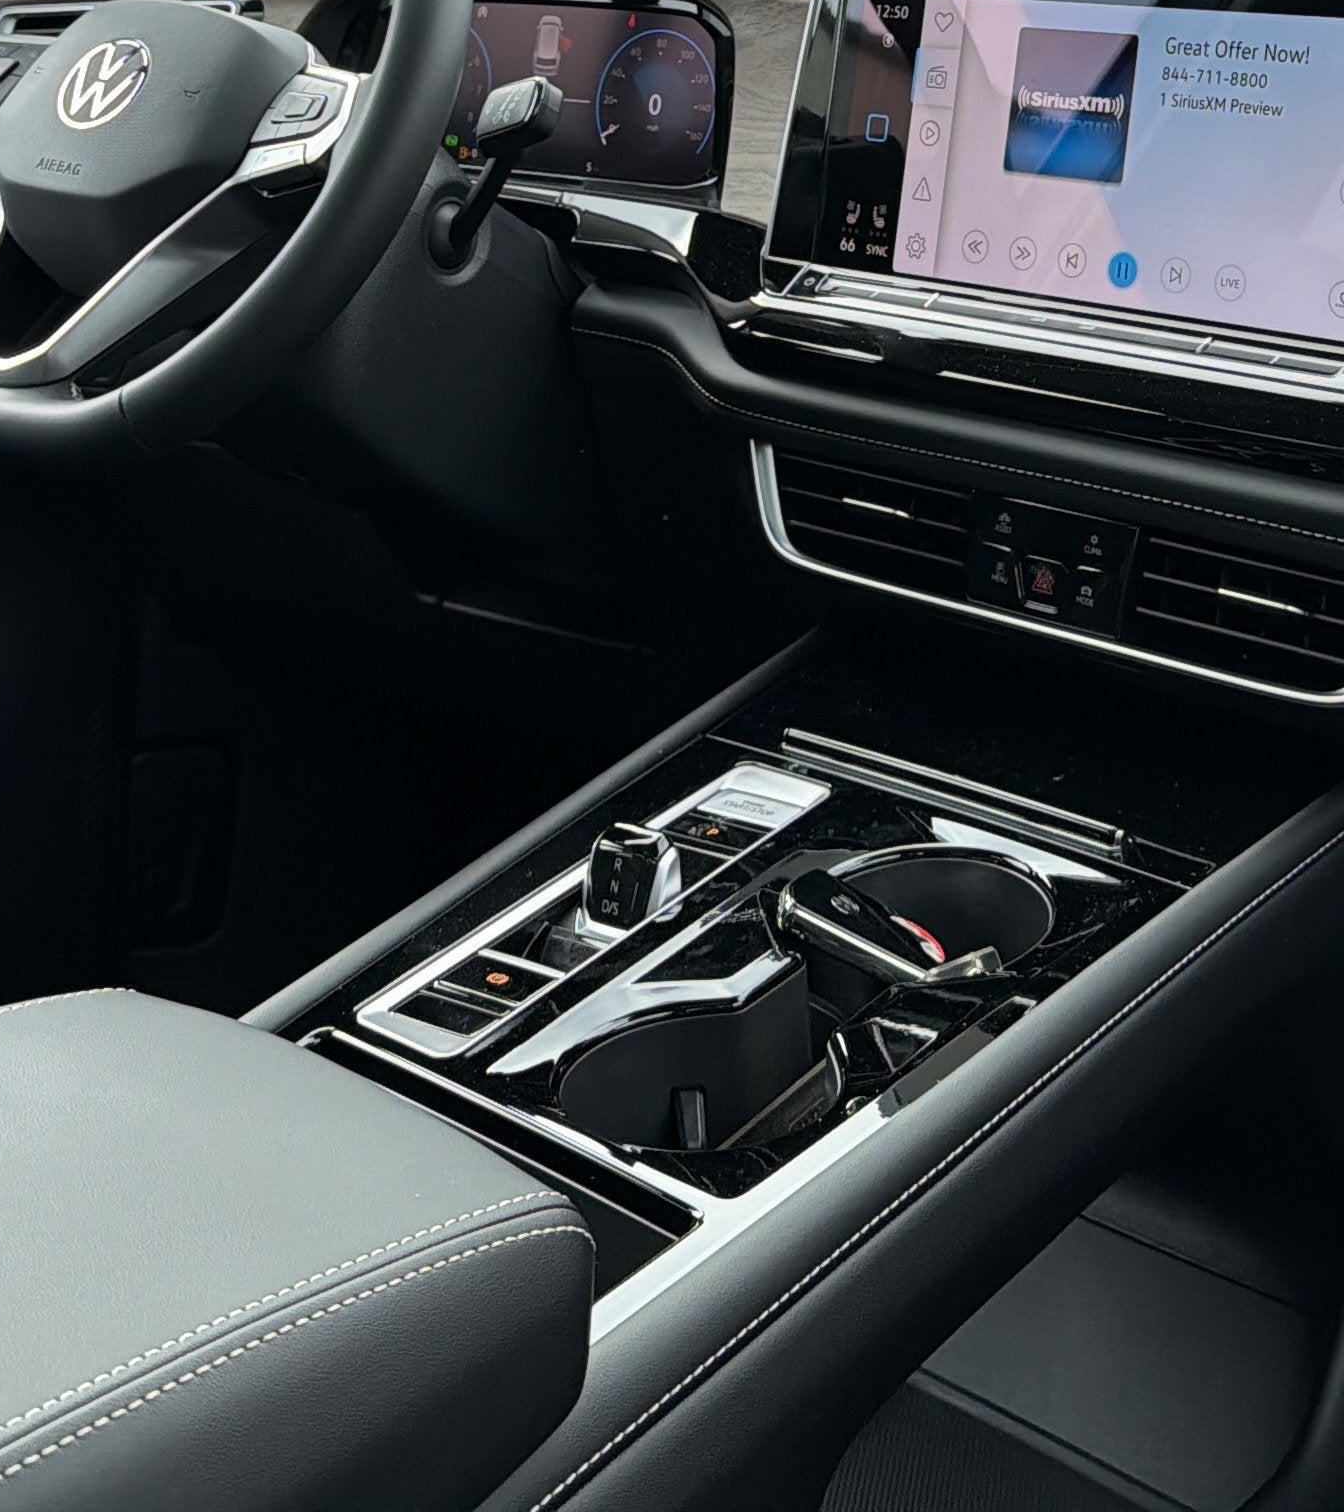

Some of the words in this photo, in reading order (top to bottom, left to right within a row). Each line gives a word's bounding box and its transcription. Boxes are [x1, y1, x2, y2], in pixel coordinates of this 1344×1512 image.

[875, 4, 909, 21] 12:50
[1165, 37, 1217, 60] Great
[1221, 39, 1261, 63] Offer
[1265, 42, 1310, 65] Now!
[1161, 66, 1268, 90] 844-711-8800
[648, 94, 662, 116] 0
[1170, 93, 1227, 114] SiriusXM
[1230, 98, 1284, 119] Preview
[35, 156, 82, 177] AIRBAG
[840, 237, 856, 252] 66
[865, 243, 888, 257] SYNC
[1220, 277, 1240, 290] LIVE
[1084, 544, 1102, 556] CLIMA
[991, 574, 1008, 584] MENU
[1076, 595, 1094, 608] MODE
[614, 857, 622, 872] R
[610, 879, 619, 894] N
[601, 899, 619, 916] D/S
